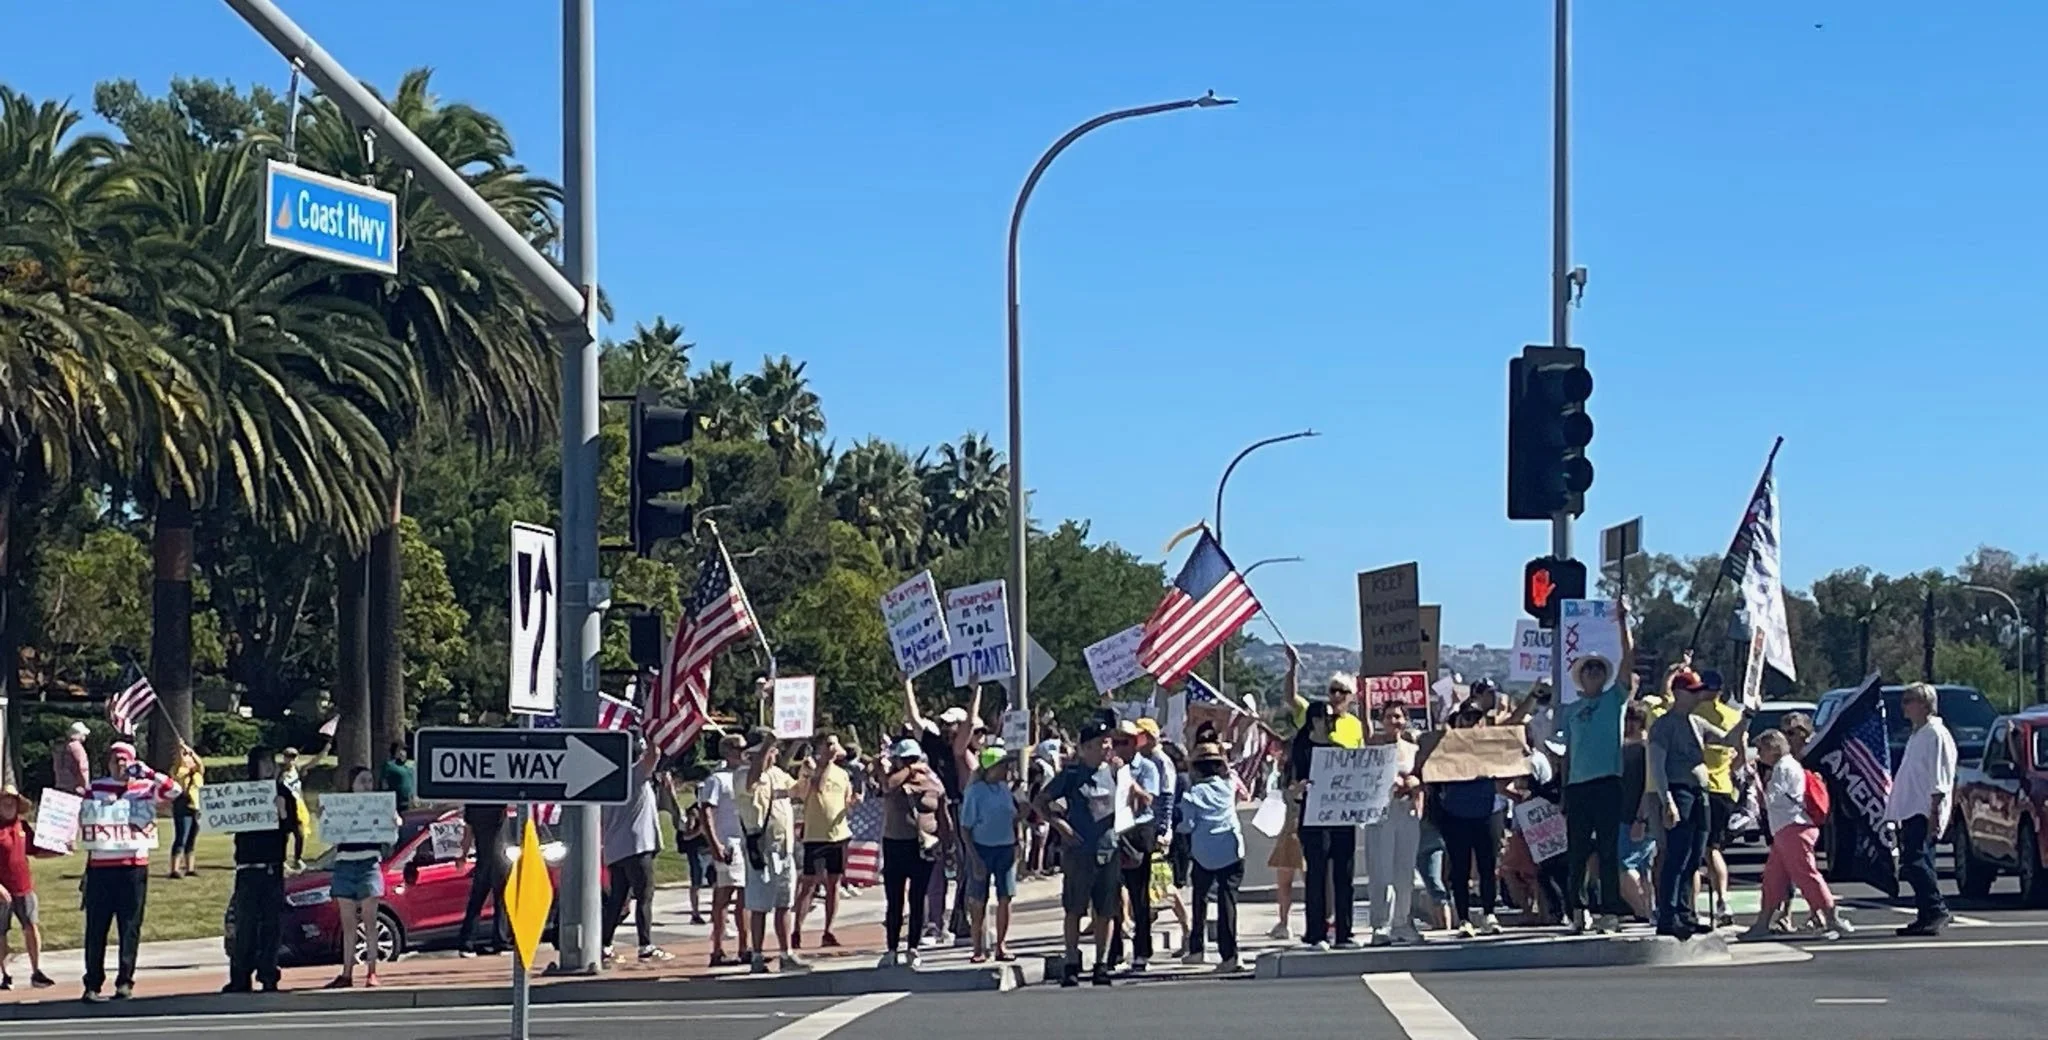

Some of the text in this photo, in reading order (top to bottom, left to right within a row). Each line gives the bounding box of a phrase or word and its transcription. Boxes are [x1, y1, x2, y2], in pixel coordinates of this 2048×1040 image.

[298, 189, 386, 257] Coast Hwy
[1369, 675, 1413, 691] STOP
[439, 751, 565, 780] ONE WAY
